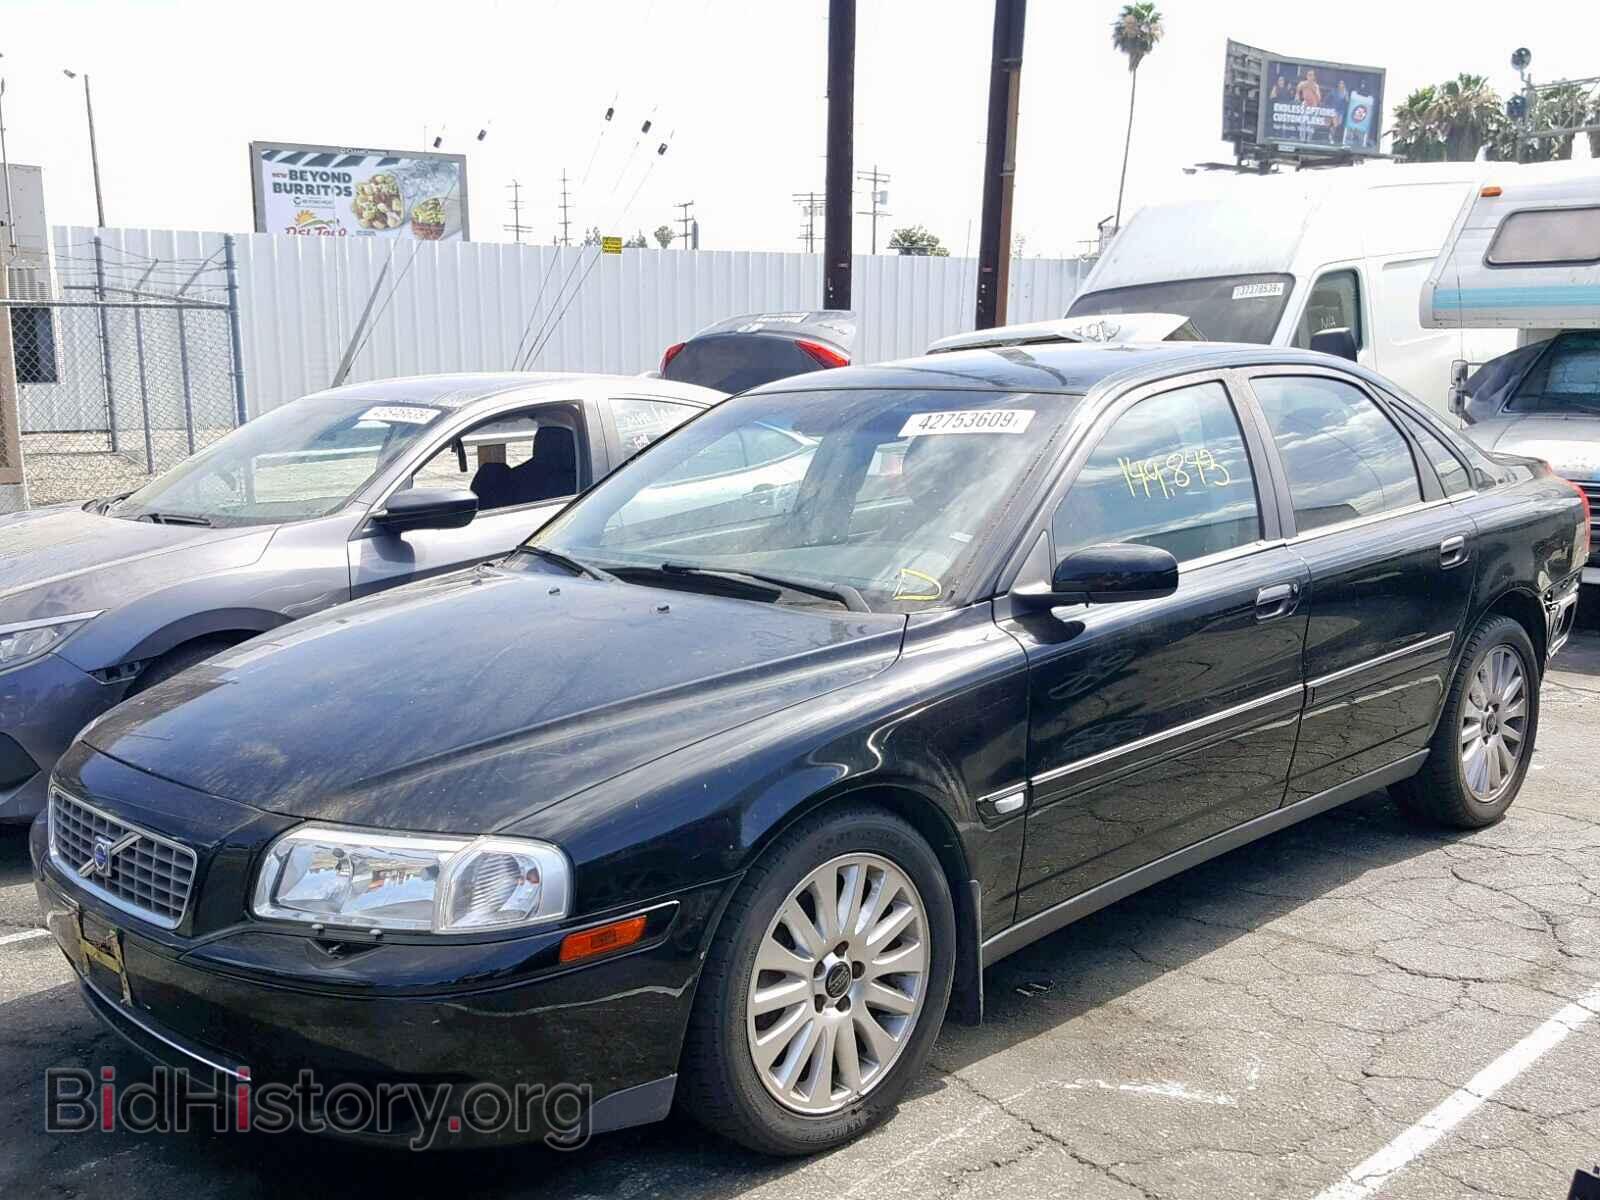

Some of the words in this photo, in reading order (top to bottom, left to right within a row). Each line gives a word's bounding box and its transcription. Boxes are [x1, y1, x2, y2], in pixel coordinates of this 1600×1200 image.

[289, 169, 352, 184] BEYOND
[272, 181, 353, 198] BURRITOS
[918, 410, 1016, 431] 42753609
